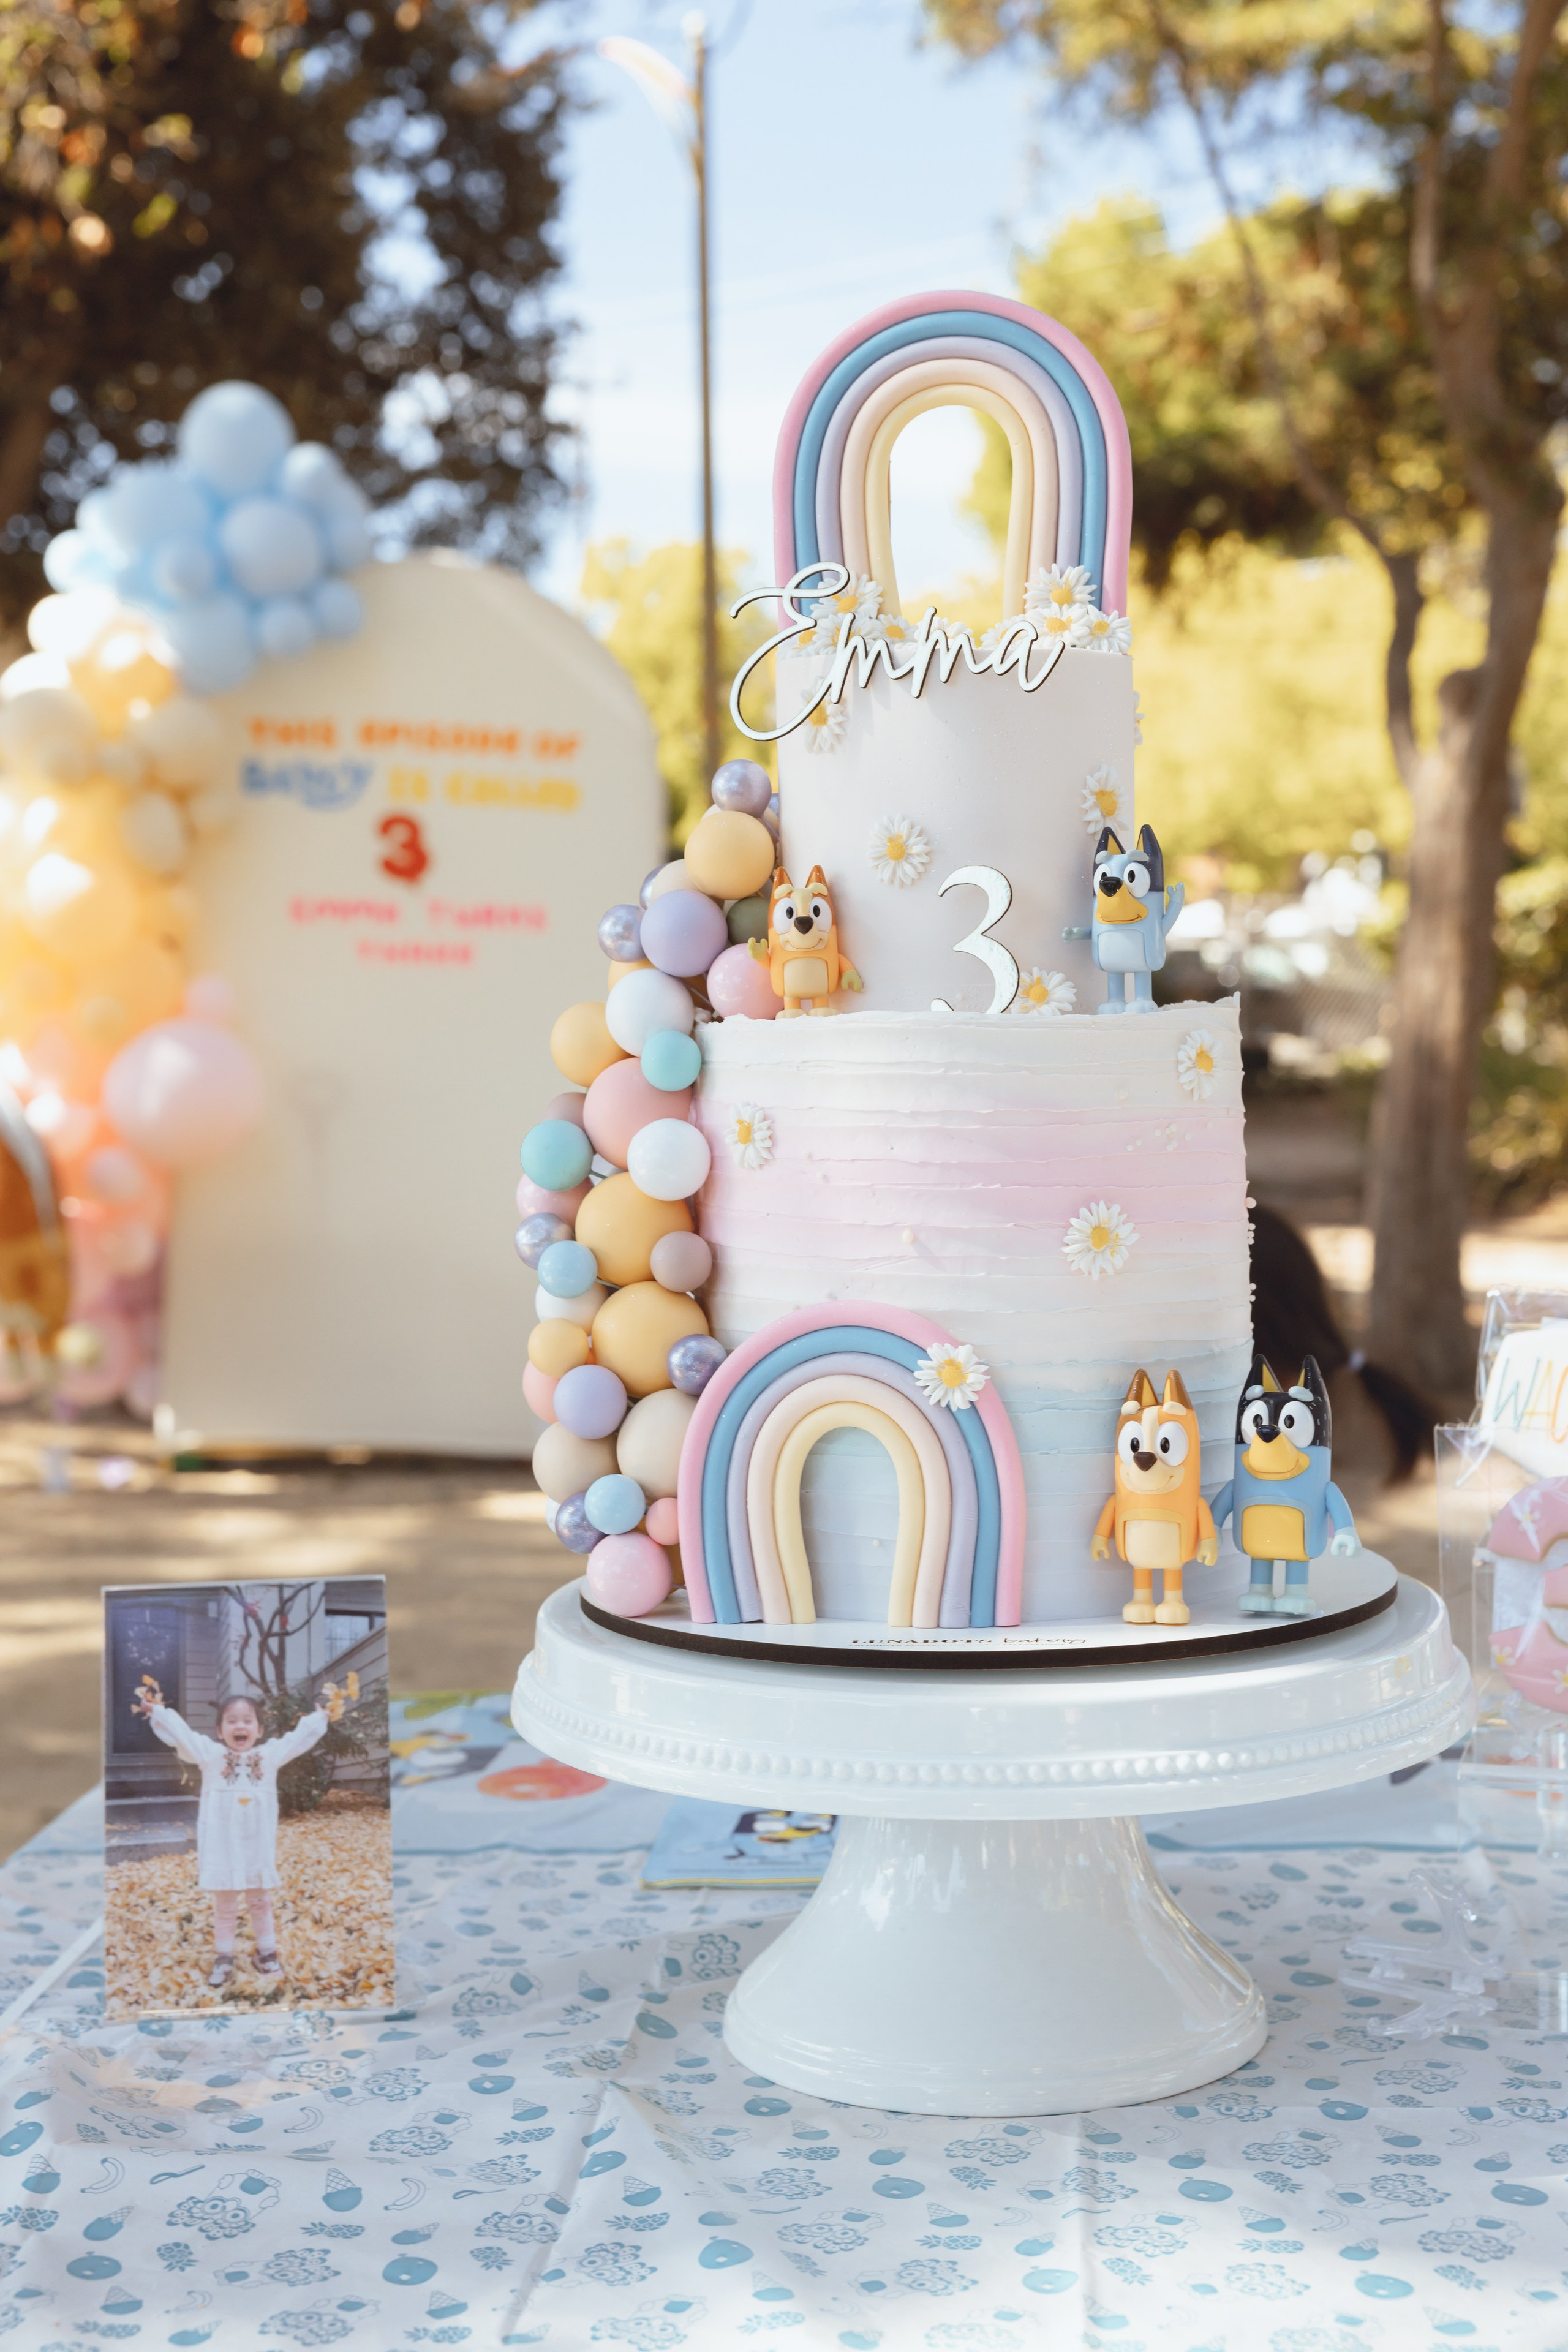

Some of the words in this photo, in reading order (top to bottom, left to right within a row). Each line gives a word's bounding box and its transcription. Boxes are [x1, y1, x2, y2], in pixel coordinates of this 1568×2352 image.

[729, 561, 1066, 742] Emma
[377, 815, 430, 884] 3
[930, 864, 1020, 1014] 3
